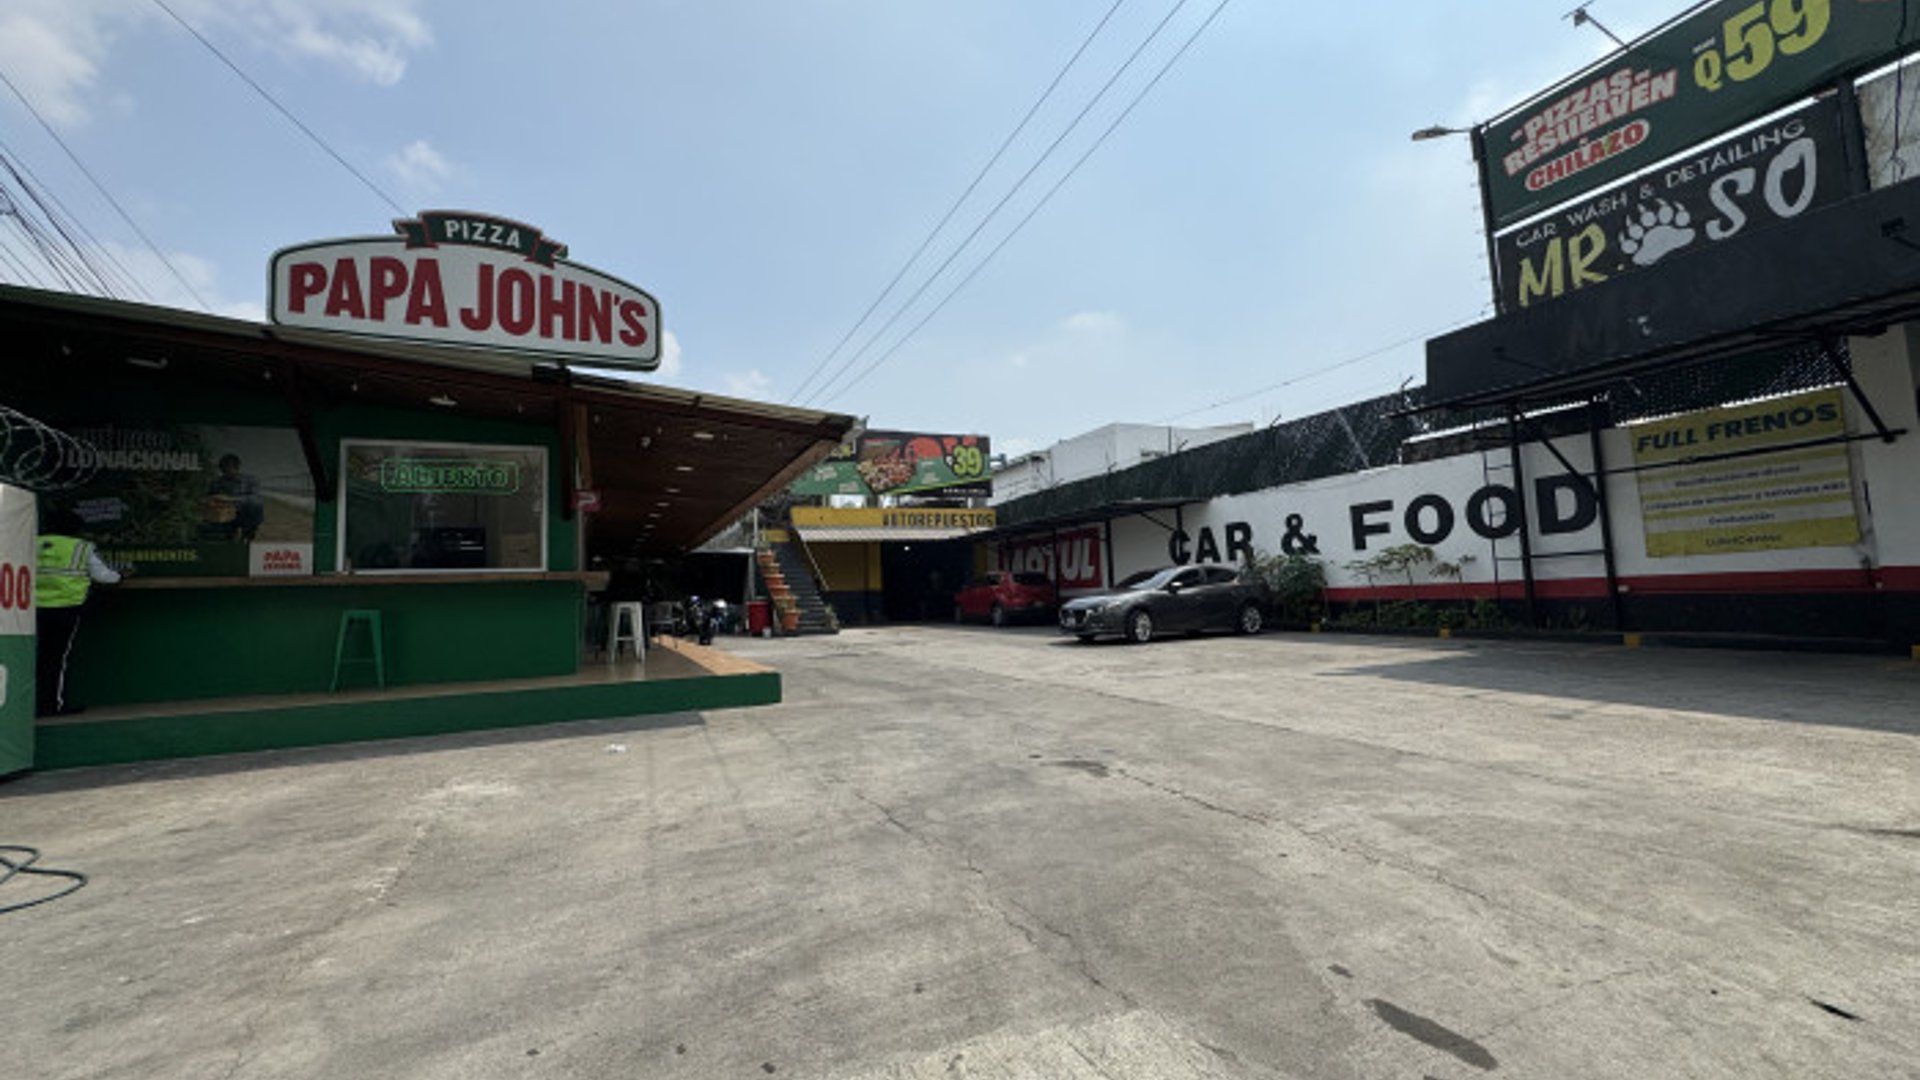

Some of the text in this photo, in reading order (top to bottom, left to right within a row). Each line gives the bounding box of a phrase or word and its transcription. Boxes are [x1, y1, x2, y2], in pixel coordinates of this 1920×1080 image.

[1503, 69, 1678, 177] RESUELVEN
[1528, 122, 1645, 189] CHILAZO
[1516, 119, 1805, 247] CAR WASH & DETAILING
[444, 219, 522, 249] PIZZA
[288, 256, 649, 348] PAPA JOHN'S
[96, 449, 204, 472] NACIONAL
[1636, 402, 1838, 453] FULL FRENOS
[882, 511, 994, 528] AUTOREPUESTOS
[1168, 520, 1254, 566] CAR
[1280, 513, 1320, 555] &
[1348, 473, 1600, 552] FOOD
